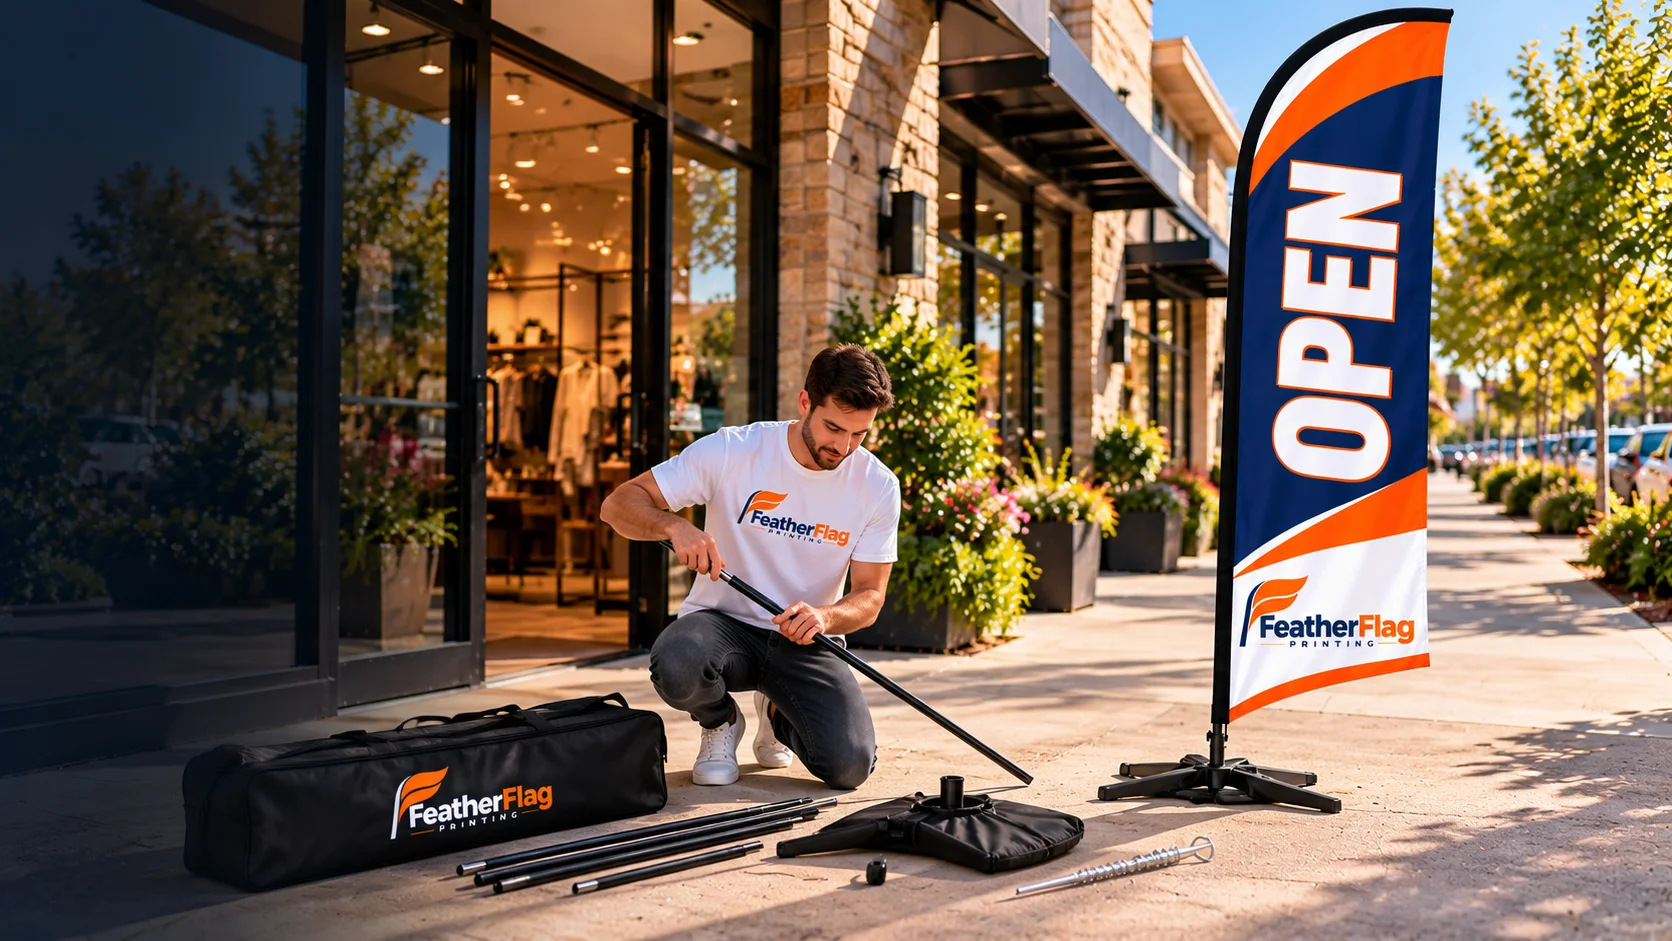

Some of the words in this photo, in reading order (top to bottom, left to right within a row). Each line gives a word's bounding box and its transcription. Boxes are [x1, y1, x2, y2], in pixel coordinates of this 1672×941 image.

[1272, 159, 1403, 483] OPEN
[750, 510, 850, 546] FeatherFlag
[768, 529, 822, 544] PRINTING
[1260, 614, 1415, 644] FeatherFlag
[1289, 640, 1374, 648] PRINTING
[409, 785, 553, 828] FeatherFlag
[439, 811, 518, 832] PRINTING
